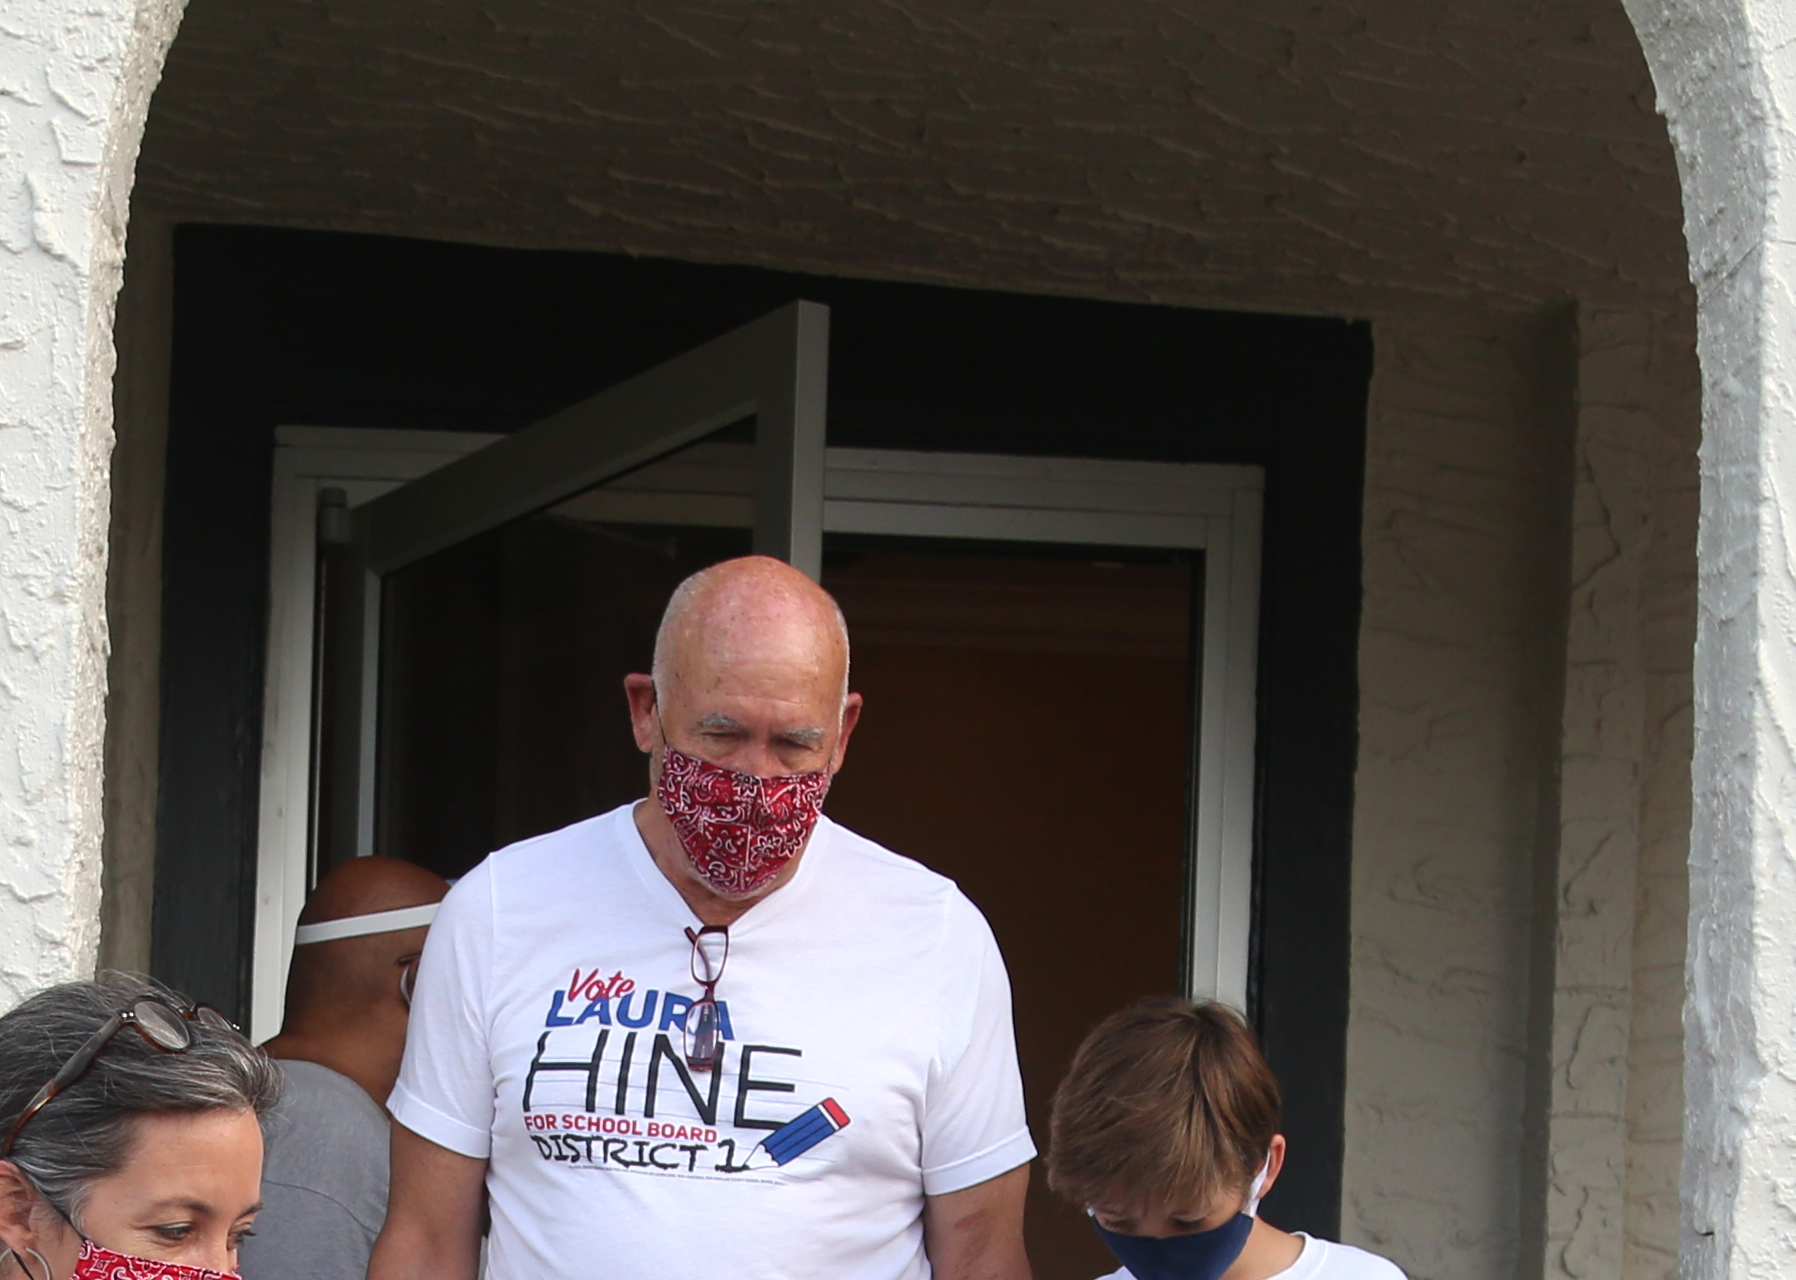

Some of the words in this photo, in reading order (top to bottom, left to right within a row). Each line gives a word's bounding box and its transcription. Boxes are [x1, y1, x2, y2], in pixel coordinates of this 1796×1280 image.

[568, 967, 636, 1002] Vote
[545, 989, 735, 1041] LAURA
[523, 1029, 802, 1131] HINE
[524, 1115, 557, 1131] FOR
[562, 1114, 643, 1136] SCHOOL
[647, 1122, 717, 1143] BOARD
[530, 1134, 710, 1172] DISTRICT
[715, 1138, 750, 1173] 1
